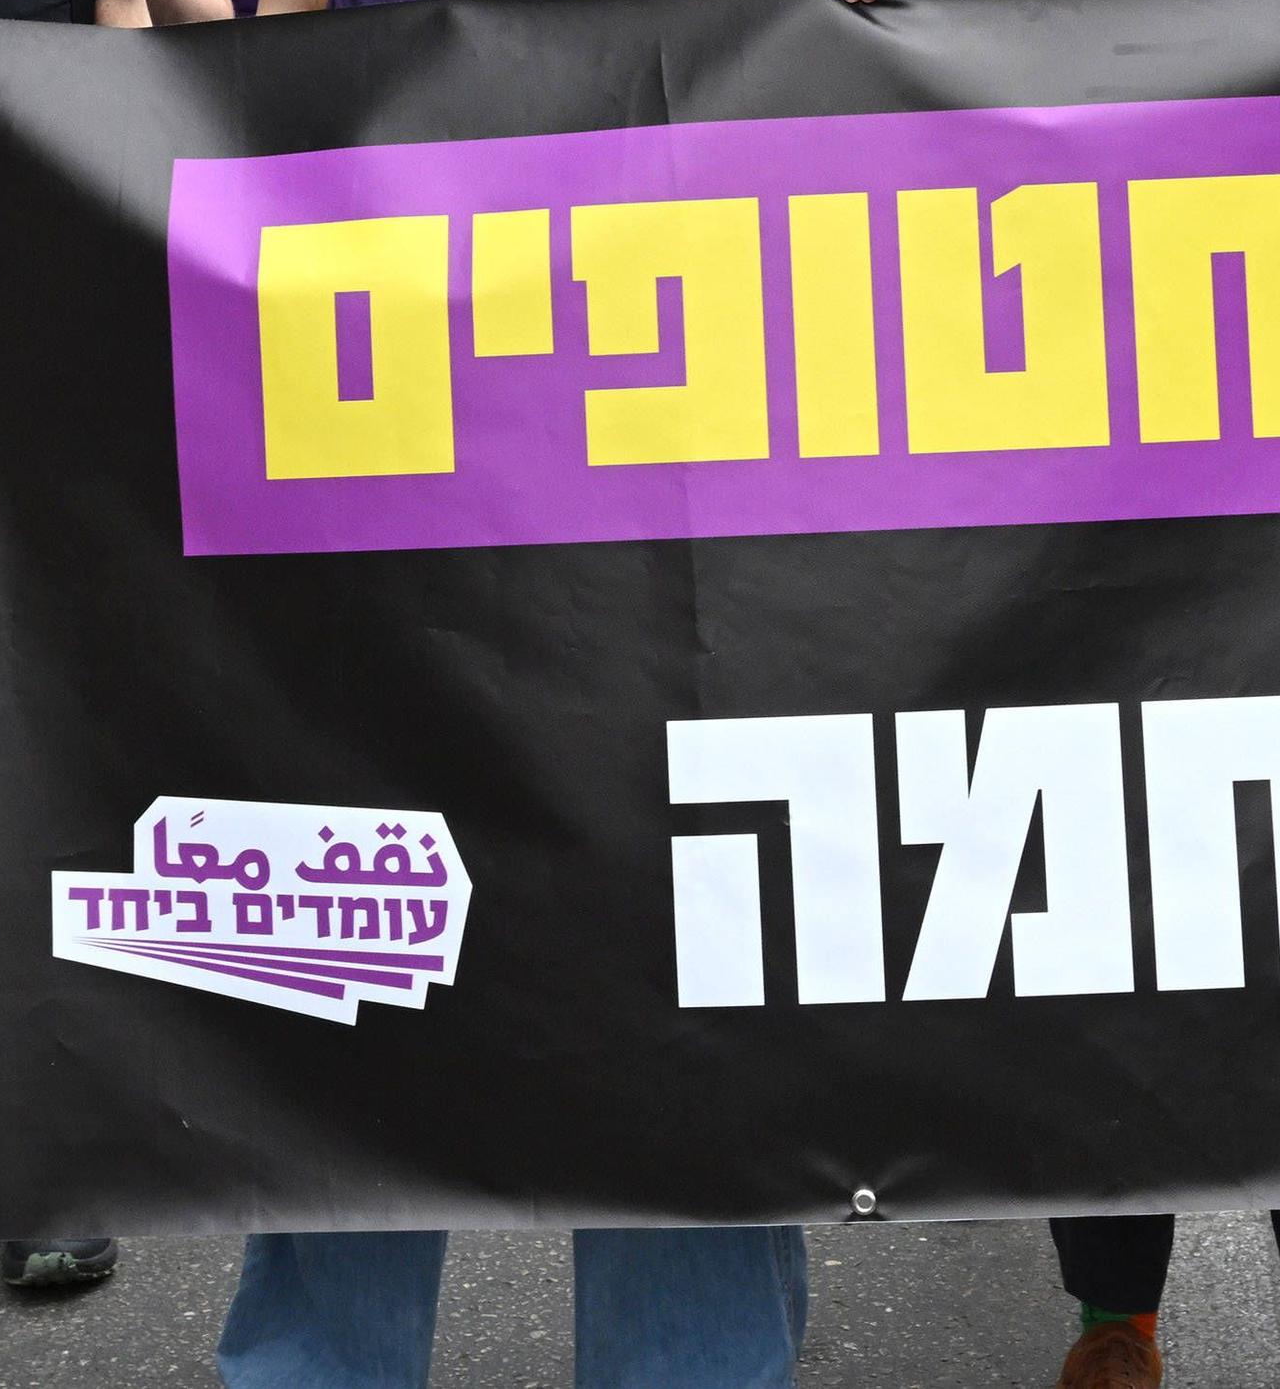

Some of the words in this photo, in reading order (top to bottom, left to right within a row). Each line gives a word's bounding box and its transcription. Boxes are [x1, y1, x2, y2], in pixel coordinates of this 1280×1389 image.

[153, 810, 270, 890] معًا
[295, 822, 447, 887] نقف
[69, 887, 212, 932] ביחד
[232, 892, 448, 945] עומדים
